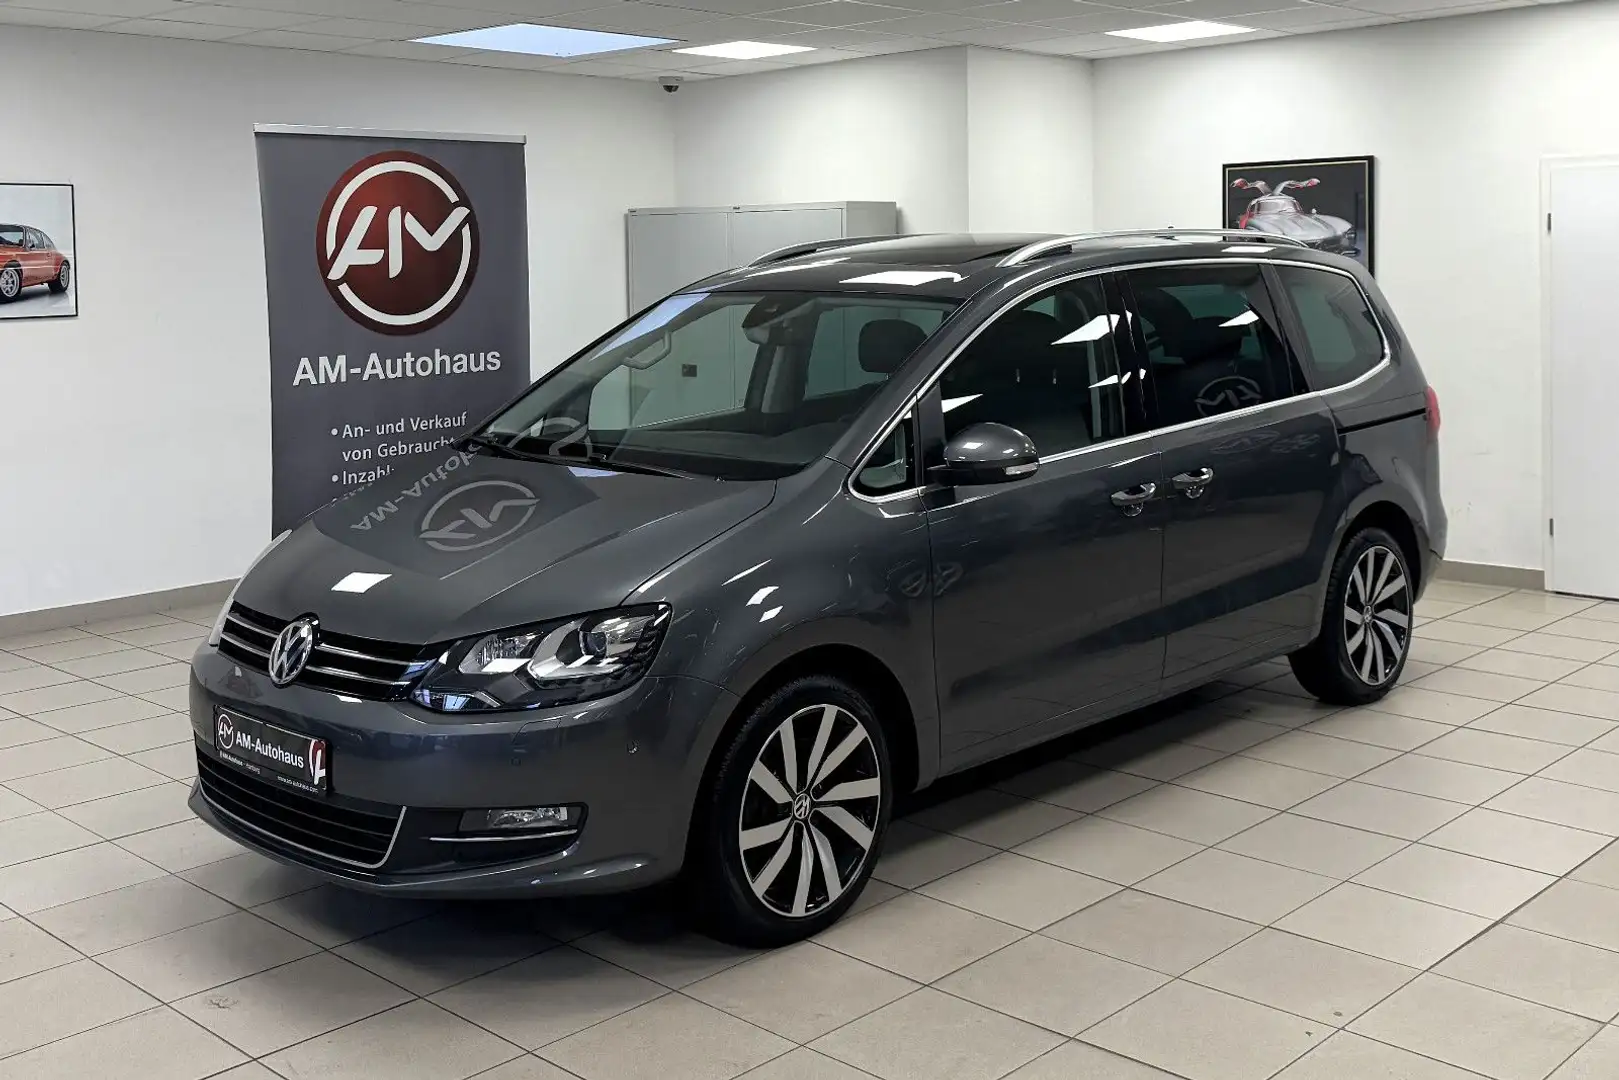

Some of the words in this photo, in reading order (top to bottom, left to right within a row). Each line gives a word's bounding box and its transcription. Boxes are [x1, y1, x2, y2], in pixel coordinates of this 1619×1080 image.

[327, 205, 471, 281] AM
[292, 348, 501, 387] AM-Autohaus
[342, 424, 371, 439] An-
[376, 418, 405, 436] und
[410, 411, 467, 431] Verkauf
[342, 448, 373, 462] von
[377, 436, 455, 458] Gebrauch
[343, 464, 395, 485] Inzahl
[236, 730, 305, 769] AM-Autohaus
